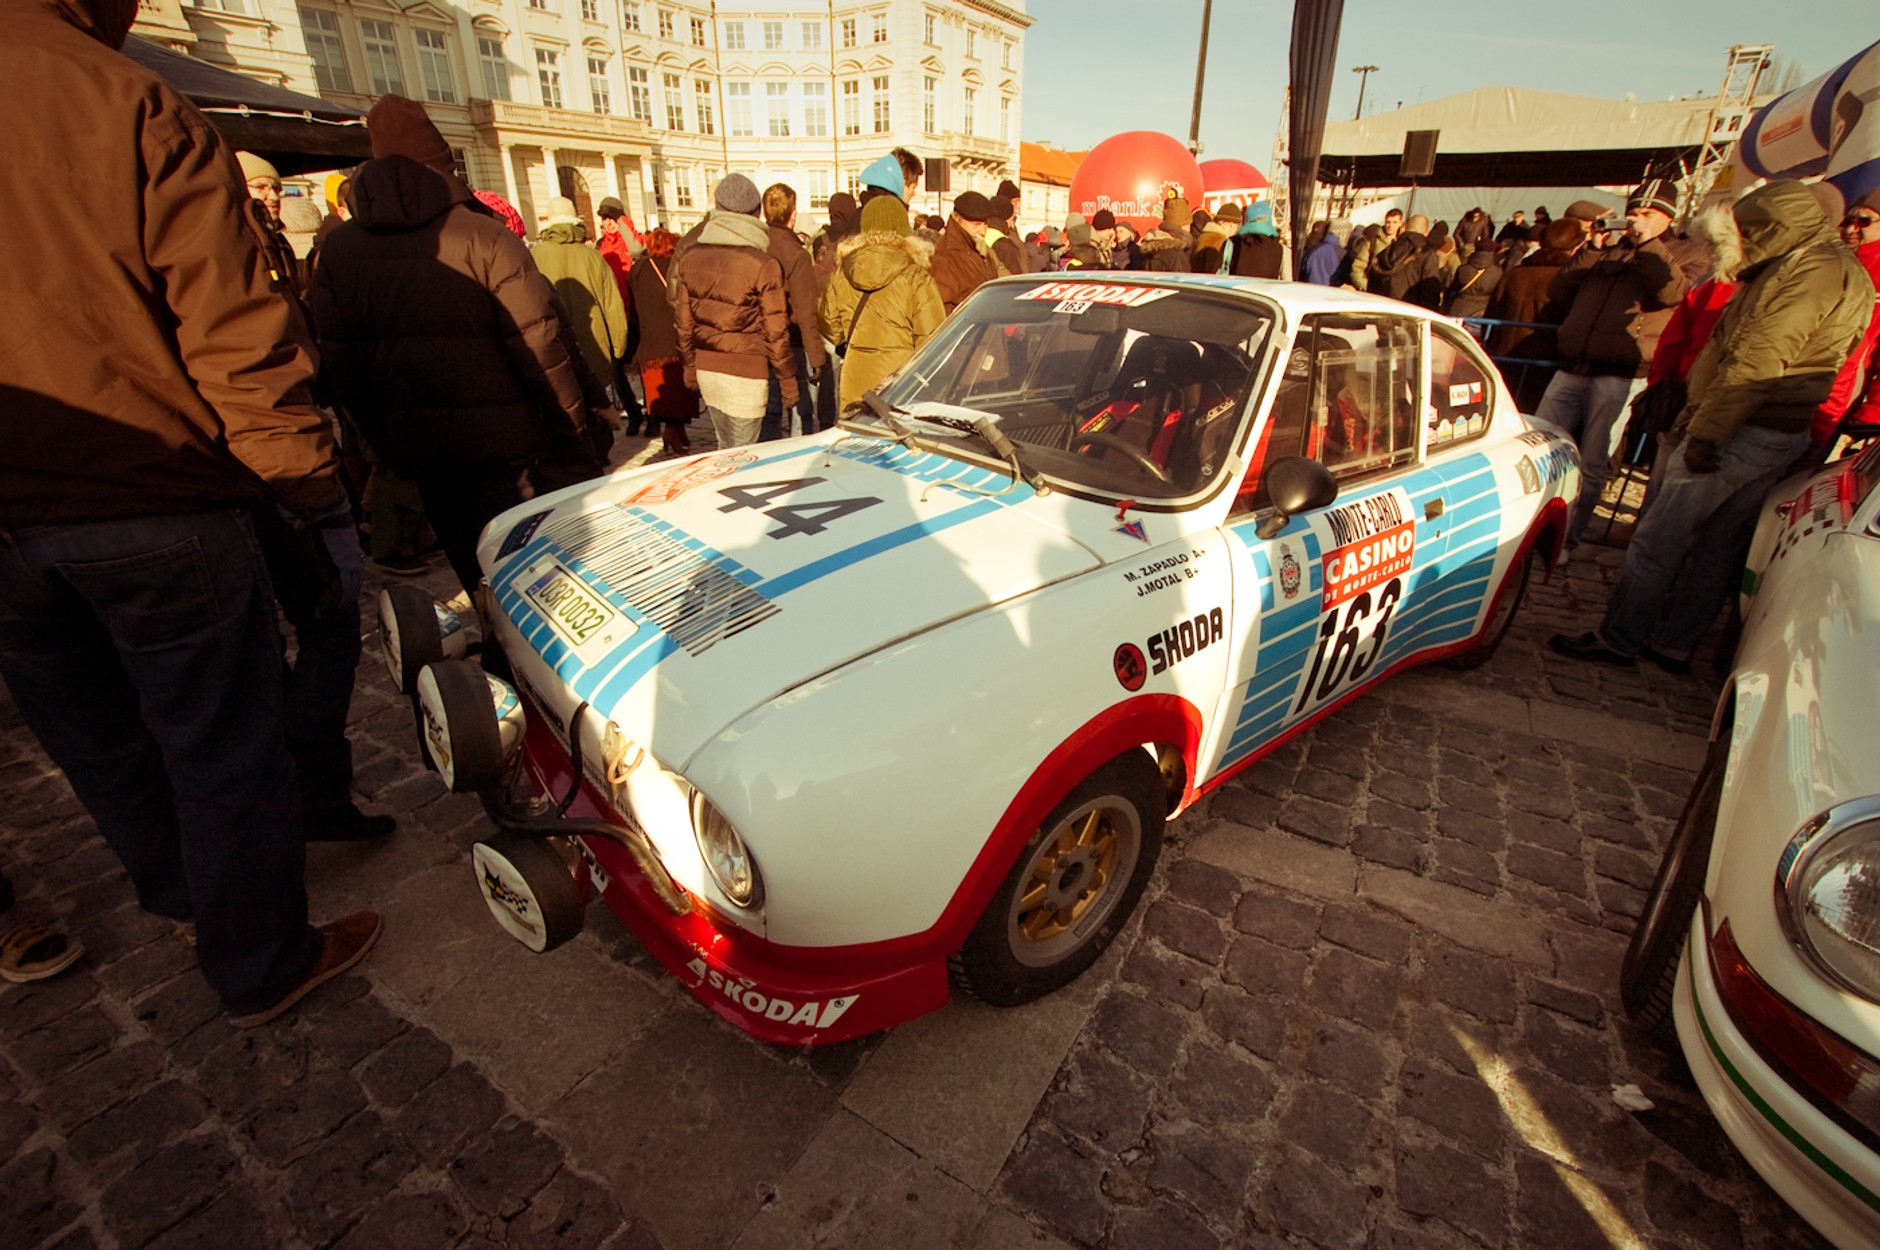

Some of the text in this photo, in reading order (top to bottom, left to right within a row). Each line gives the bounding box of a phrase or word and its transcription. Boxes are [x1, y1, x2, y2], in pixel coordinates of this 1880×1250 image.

[1081, 195, 1150, 218] mBank
[1059, 301, 1085, 312] 163
[716, 476, 885, 540] 44
[1324, 492, 1403, 548] MONTE-CARLO
[1123, 571, 1141, 583] M.
[1139, 553, 1189, 579] ZAPADLO
[1324, 555, 1412, 604] DE MONTE-CARLO
[1326, 529, 1414, 585] CASINO
[1293, 577, 1402, 716] 163
